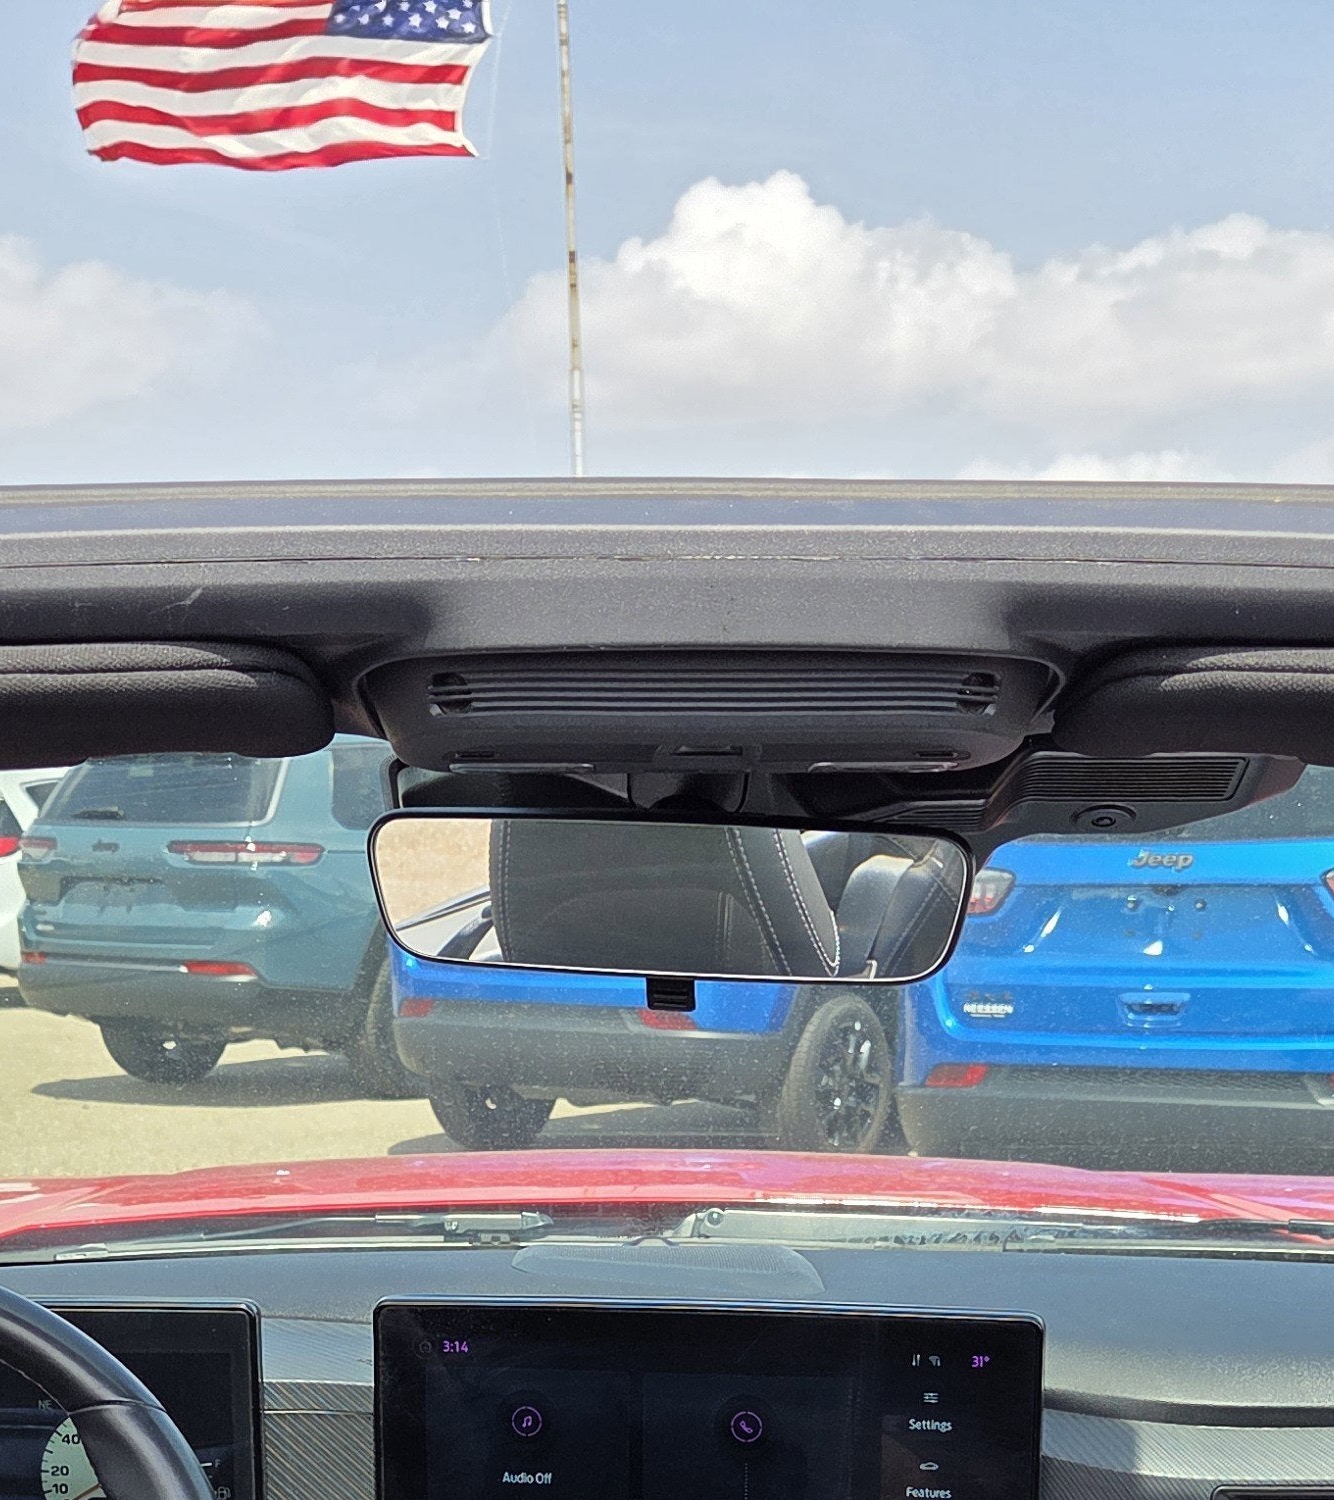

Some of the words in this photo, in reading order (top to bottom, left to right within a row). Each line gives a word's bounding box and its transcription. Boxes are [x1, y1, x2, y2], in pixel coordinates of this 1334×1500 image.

[1130, 849, 1194, 871] Jeep
[442, 1340, 469, 1354] 3:14
[971, 1355, 991, 1369] 31°
[908, 1417, 953, 1434] Settings
[61, 1433, 81, 1445] 40
[50, 1465, 69, 1476] 20
[501, 1471, 535, 1485] Audio
[536, 1471, 553, 1485] Off
[51, 1483, 69, 1495] 10
[905, 1486, 952, 1500] Features
